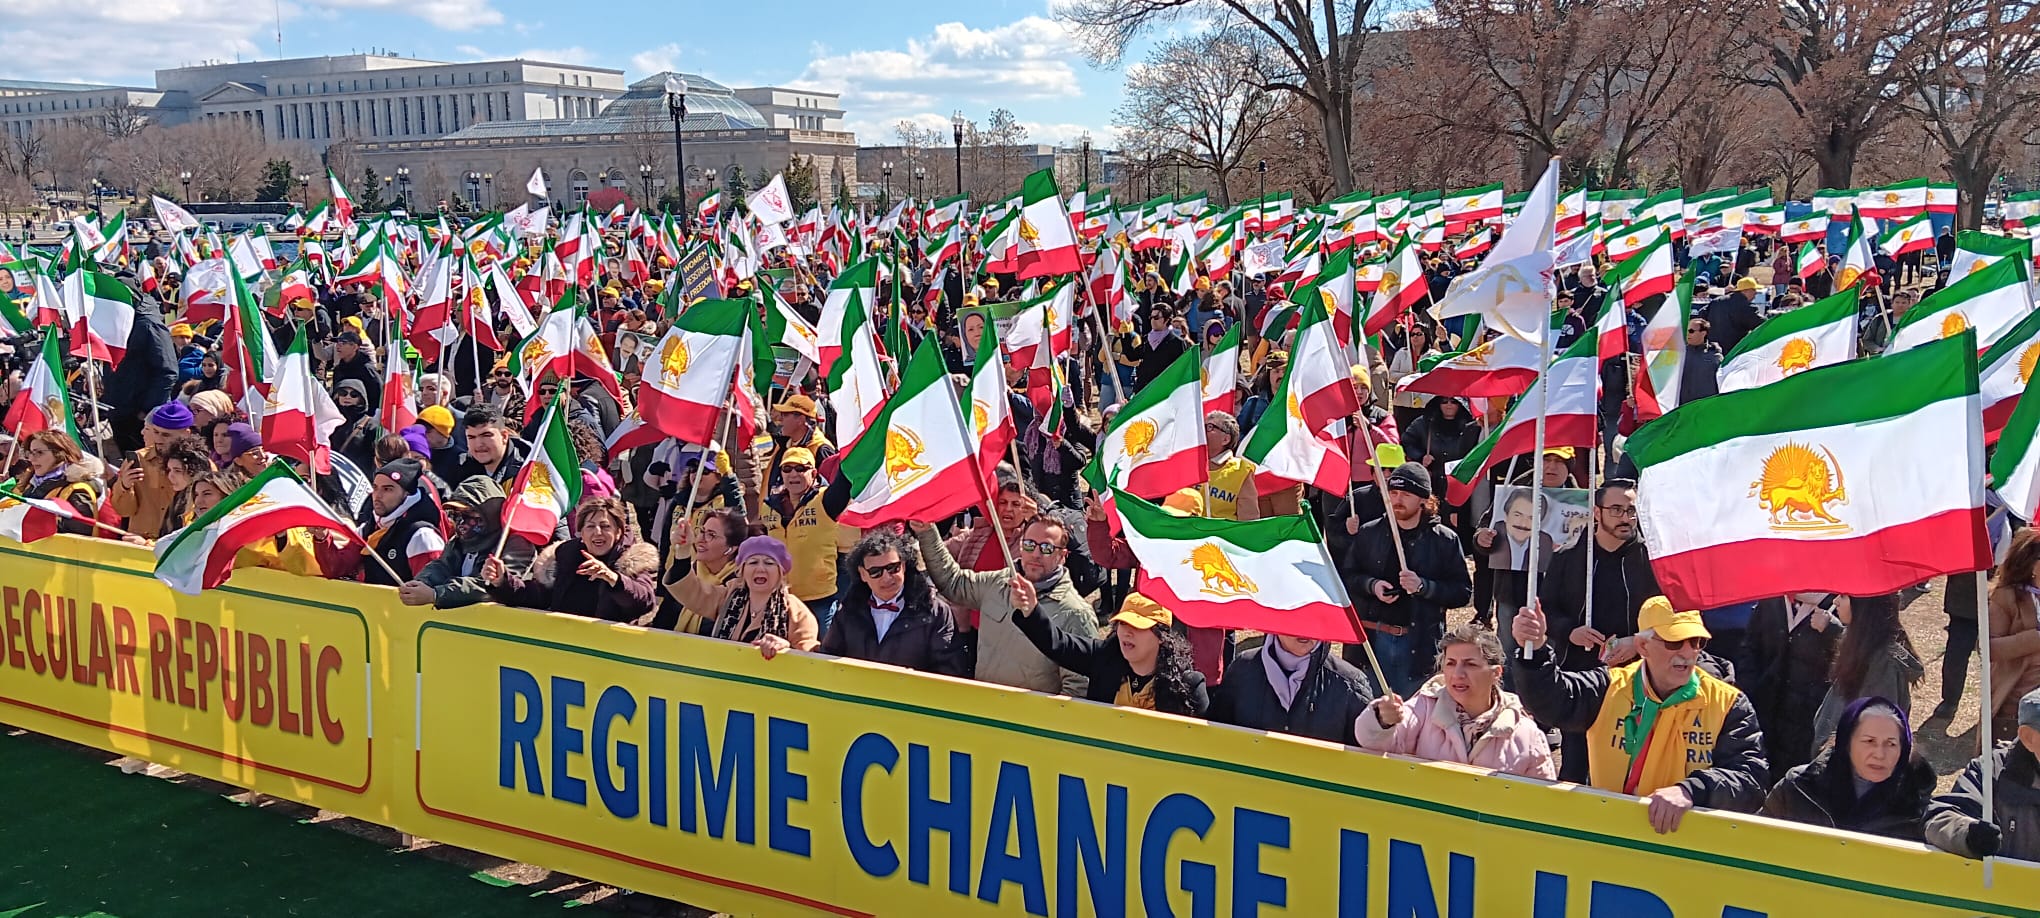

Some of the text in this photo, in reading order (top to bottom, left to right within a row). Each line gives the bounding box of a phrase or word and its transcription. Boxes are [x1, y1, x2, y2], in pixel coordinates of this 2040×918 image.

[683, 249, 707, 273] WOMEN
[0, 586, 345, 745] ECULAR REPUBLIC
[499, 665, 812, 858] REGIME
[840, 732, 1290, 918] CHANGE
